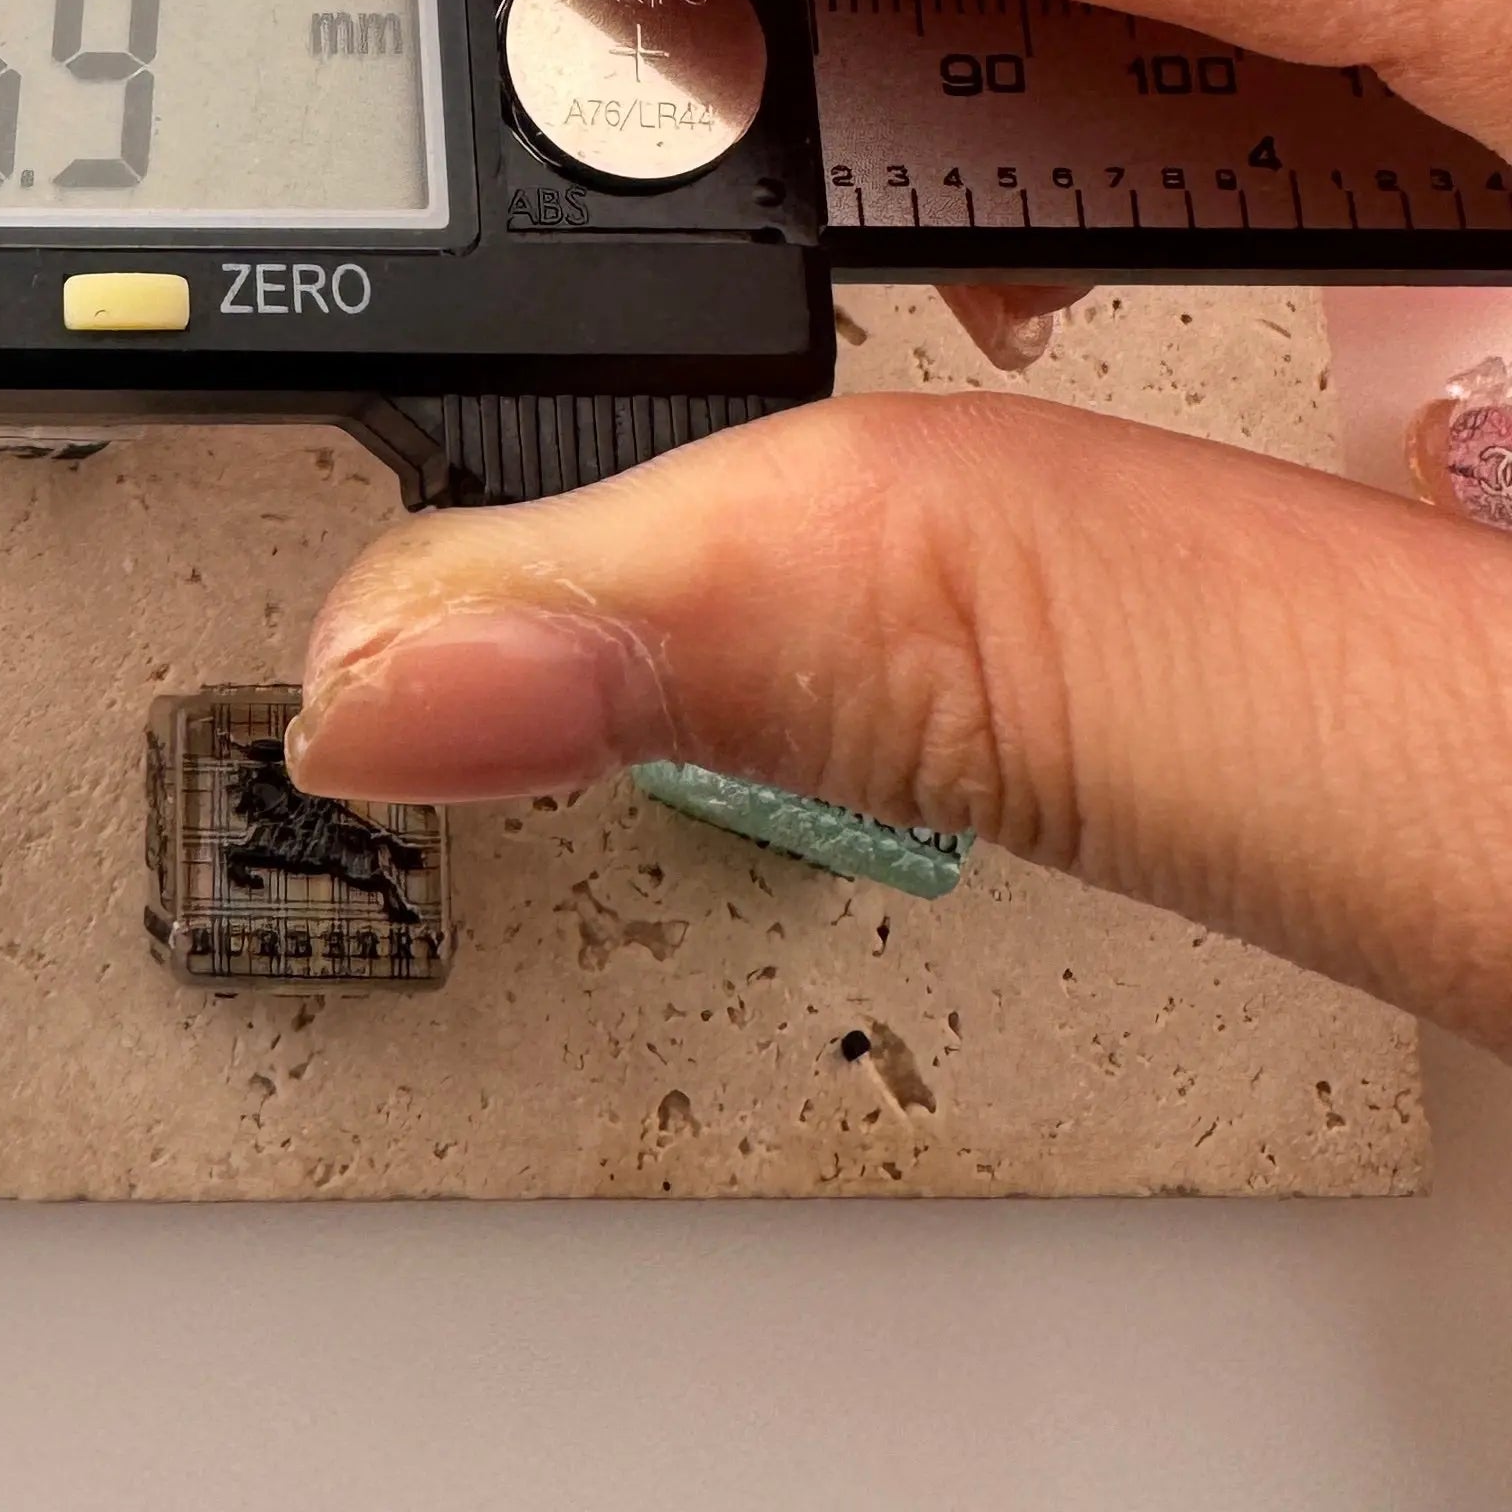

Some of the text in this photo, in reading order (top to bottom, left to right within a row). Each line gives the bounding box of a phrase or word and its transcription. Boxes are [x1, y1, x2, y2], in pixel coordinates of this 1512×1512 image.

[310, 11, 405, 55] mm
[940, 53, 1237, 96] 90 100
[563, 98, 716, 133] A76/LR44
[1248, 135, 1283, 171] 4
[830, 164, 855, 187] 2
[886, 164, 910, 187] 3
[943, 167, 966, 188] 4
[997, 167, 1018, 188] 5
[1052, 167, 1075, 188] 6
[1104, 167, 1126, 188] 7
[1160, 167, 1185, 189] 8
[1215, 168, 1237, 190] 9
[1374, 169, 1399, 191] 2
[1429, 168, 1454, 191] 3
[506, 187, 590, 226] ABS
[220, 262, 372, 316] ZERO
